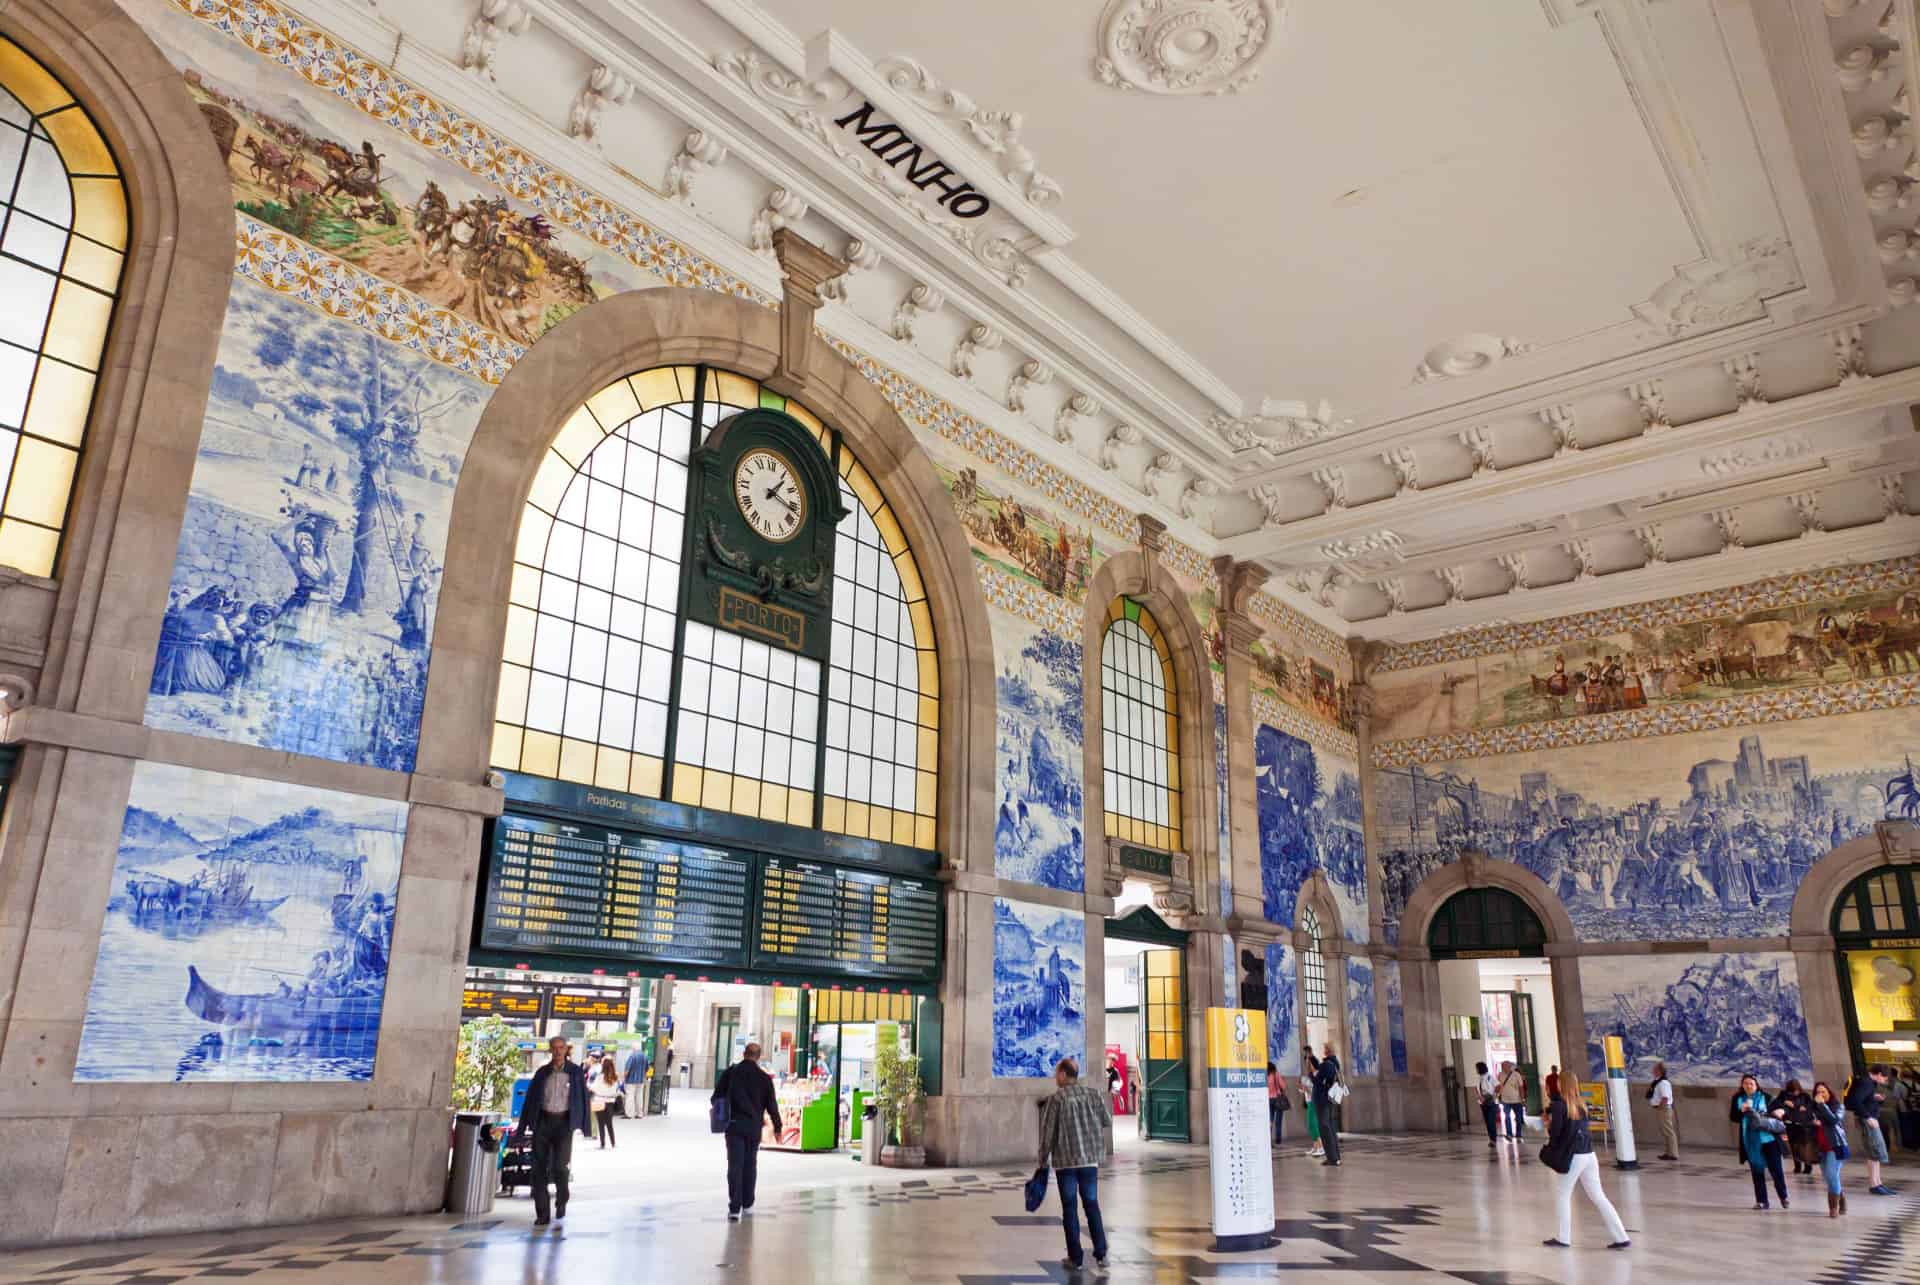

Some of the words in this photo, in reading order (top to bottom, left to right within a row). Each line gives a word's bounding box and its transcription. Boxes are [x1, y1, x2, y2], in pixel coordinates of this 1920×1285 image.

[834, 101, 990, 218] MINHO
[735, 598, 792, 634] PORTO
[586, 792, 627, 809] Partidas
